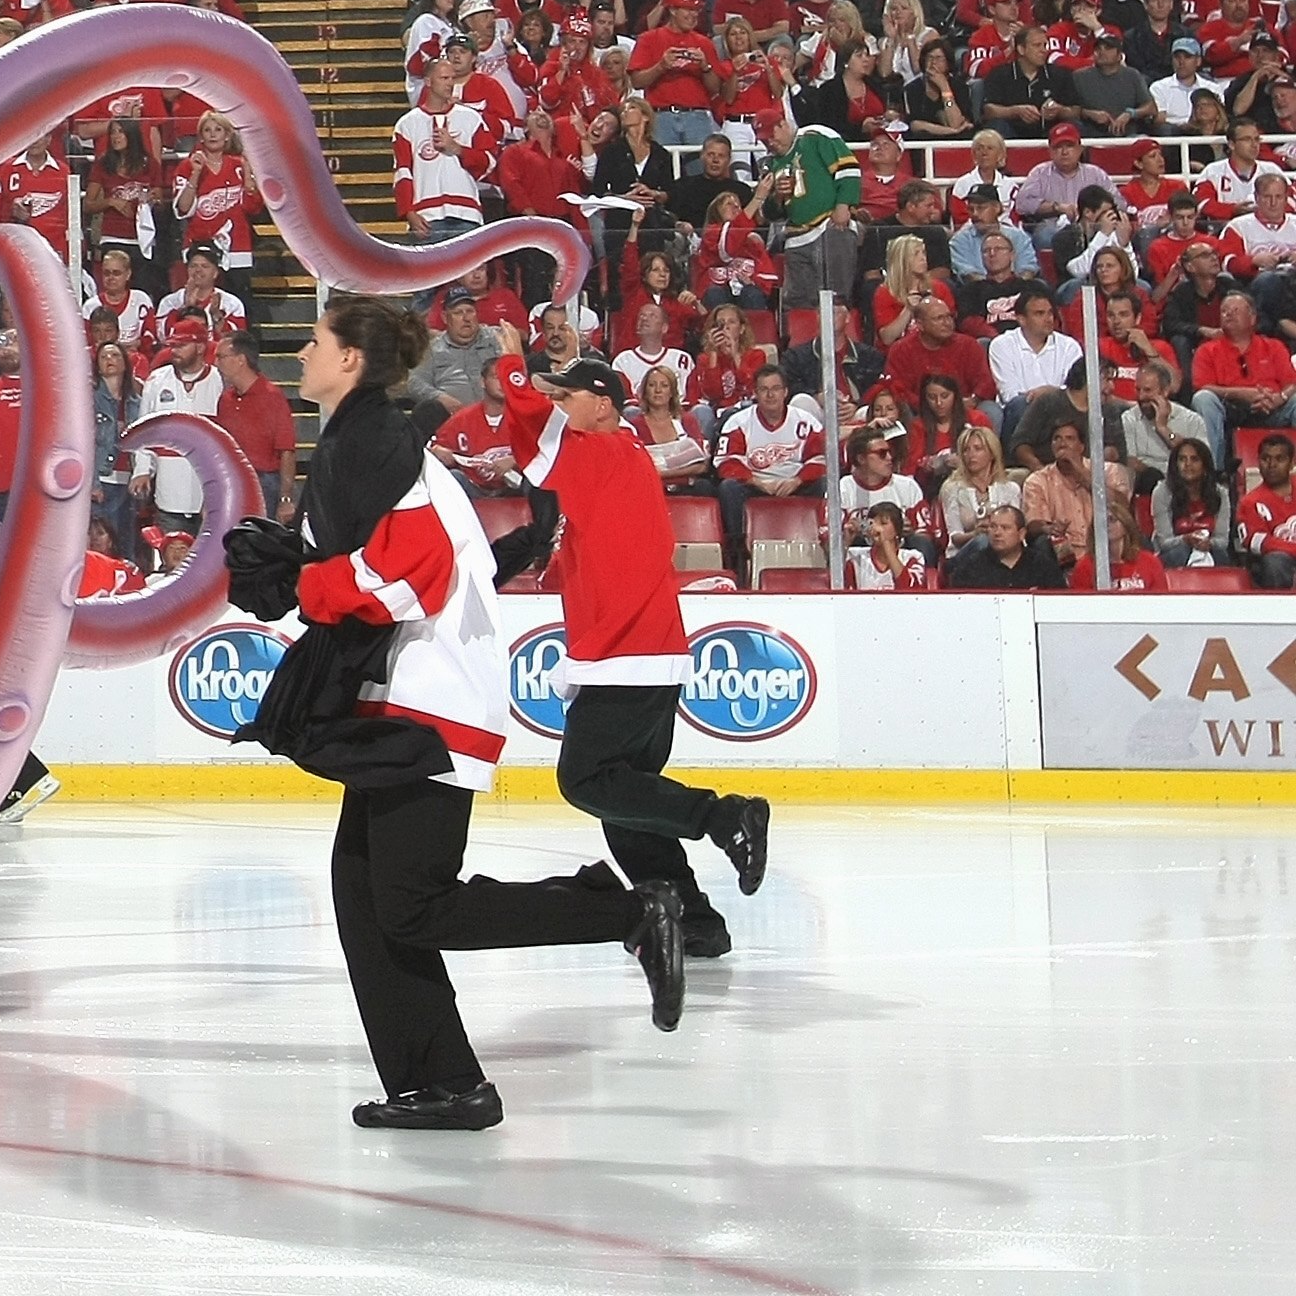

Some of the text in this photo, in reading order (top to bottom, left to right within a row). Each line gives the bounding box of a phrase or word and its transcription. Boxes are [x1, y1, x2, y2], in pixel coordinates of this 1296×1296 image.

[188, 640, 275, 725] Krog
[686, 638, 804, 727] Kroger
[1203, 719, 1296, 757] WI
